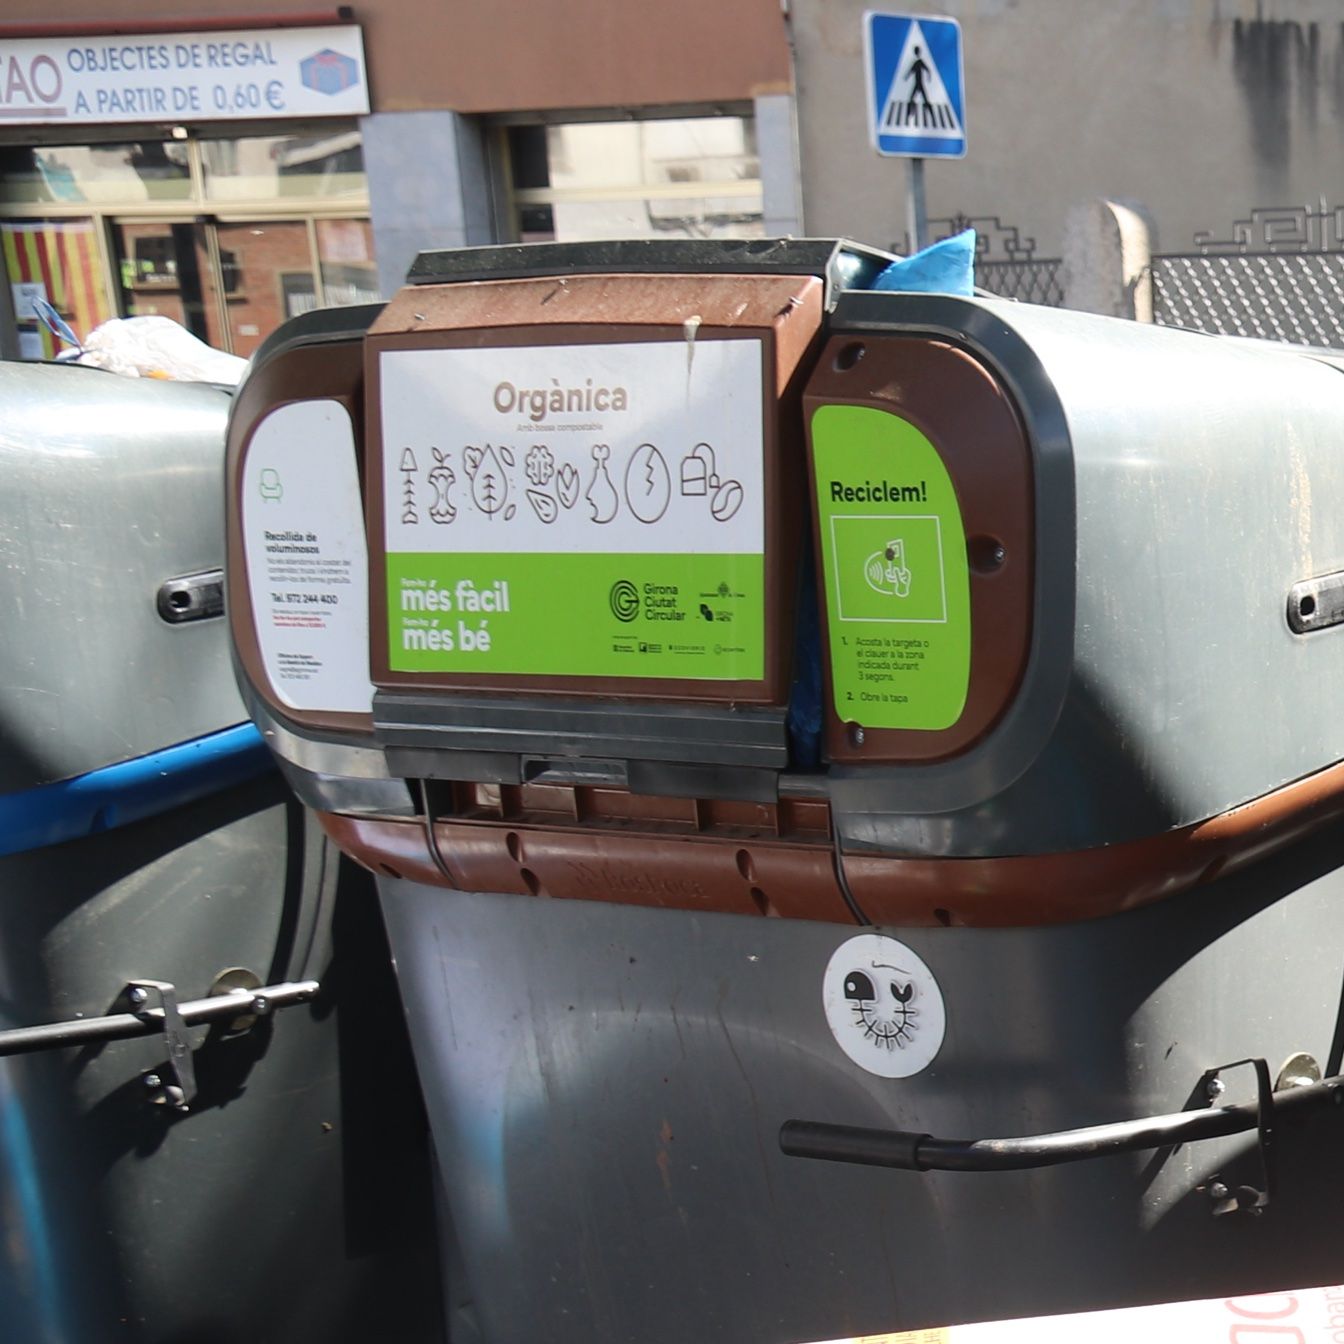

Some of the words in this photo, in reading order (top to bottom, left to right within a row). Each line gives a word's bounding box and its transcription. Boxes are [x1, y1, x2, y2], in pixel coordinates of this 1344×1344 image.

[67, 45, 170, 72] OBJECTES
[173, 46, 201, 69] DE
[207, 41, 277, 68] REGAL
[0, 54, 63, 104] AO
[74, 90, 91, 115] A
[96, 88, 167, 113] PARTIR
[173, 85, 200, 112] DE
[493, 378, 628, 422] Orgànica
[829, 480, 928, 502] Reciclem!
[401, 580, 452, 611] més
[643, 583, 679, 595] Girona
[644, 596, 677, 608] Ciutat
[645, 609, 687, 621] Circular
[403, 620, 454, 651] més
[458, 620, 491, 652] bé
